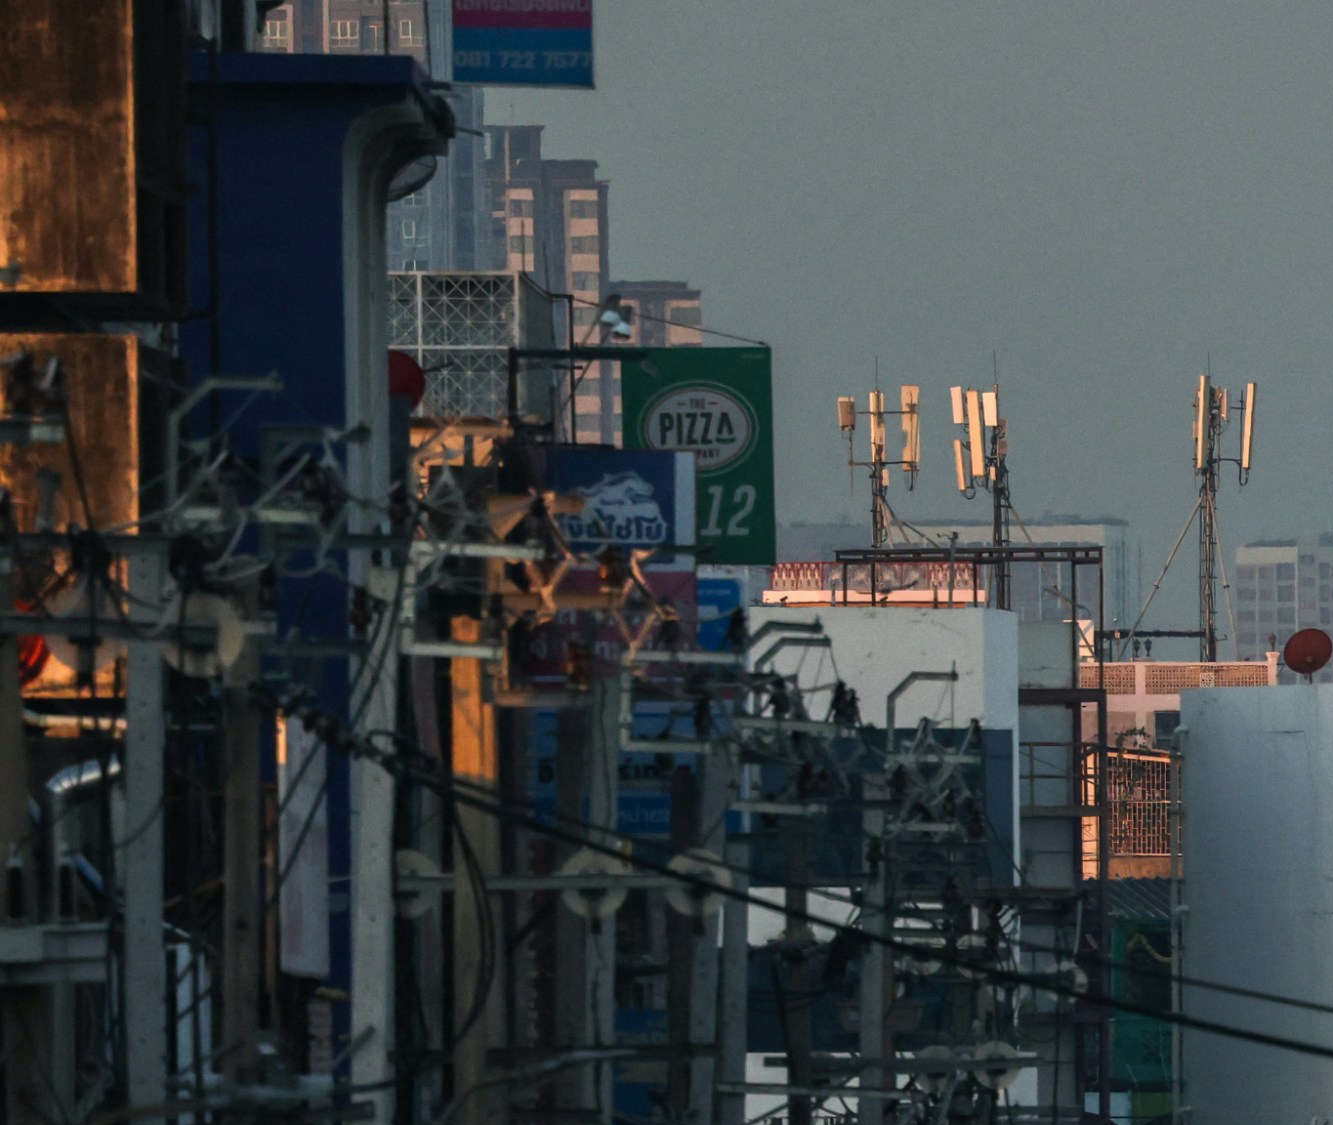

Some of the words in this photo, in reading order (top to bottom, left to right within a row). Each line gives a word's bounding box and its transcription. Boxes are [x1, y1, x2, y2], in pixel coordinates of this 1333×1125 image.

[499, 50, 534, 68] 722
[689, 398, 706, 409] THE
[659, 412, 736, 445] PIZZA
[700, 484, 756, 537] 12
